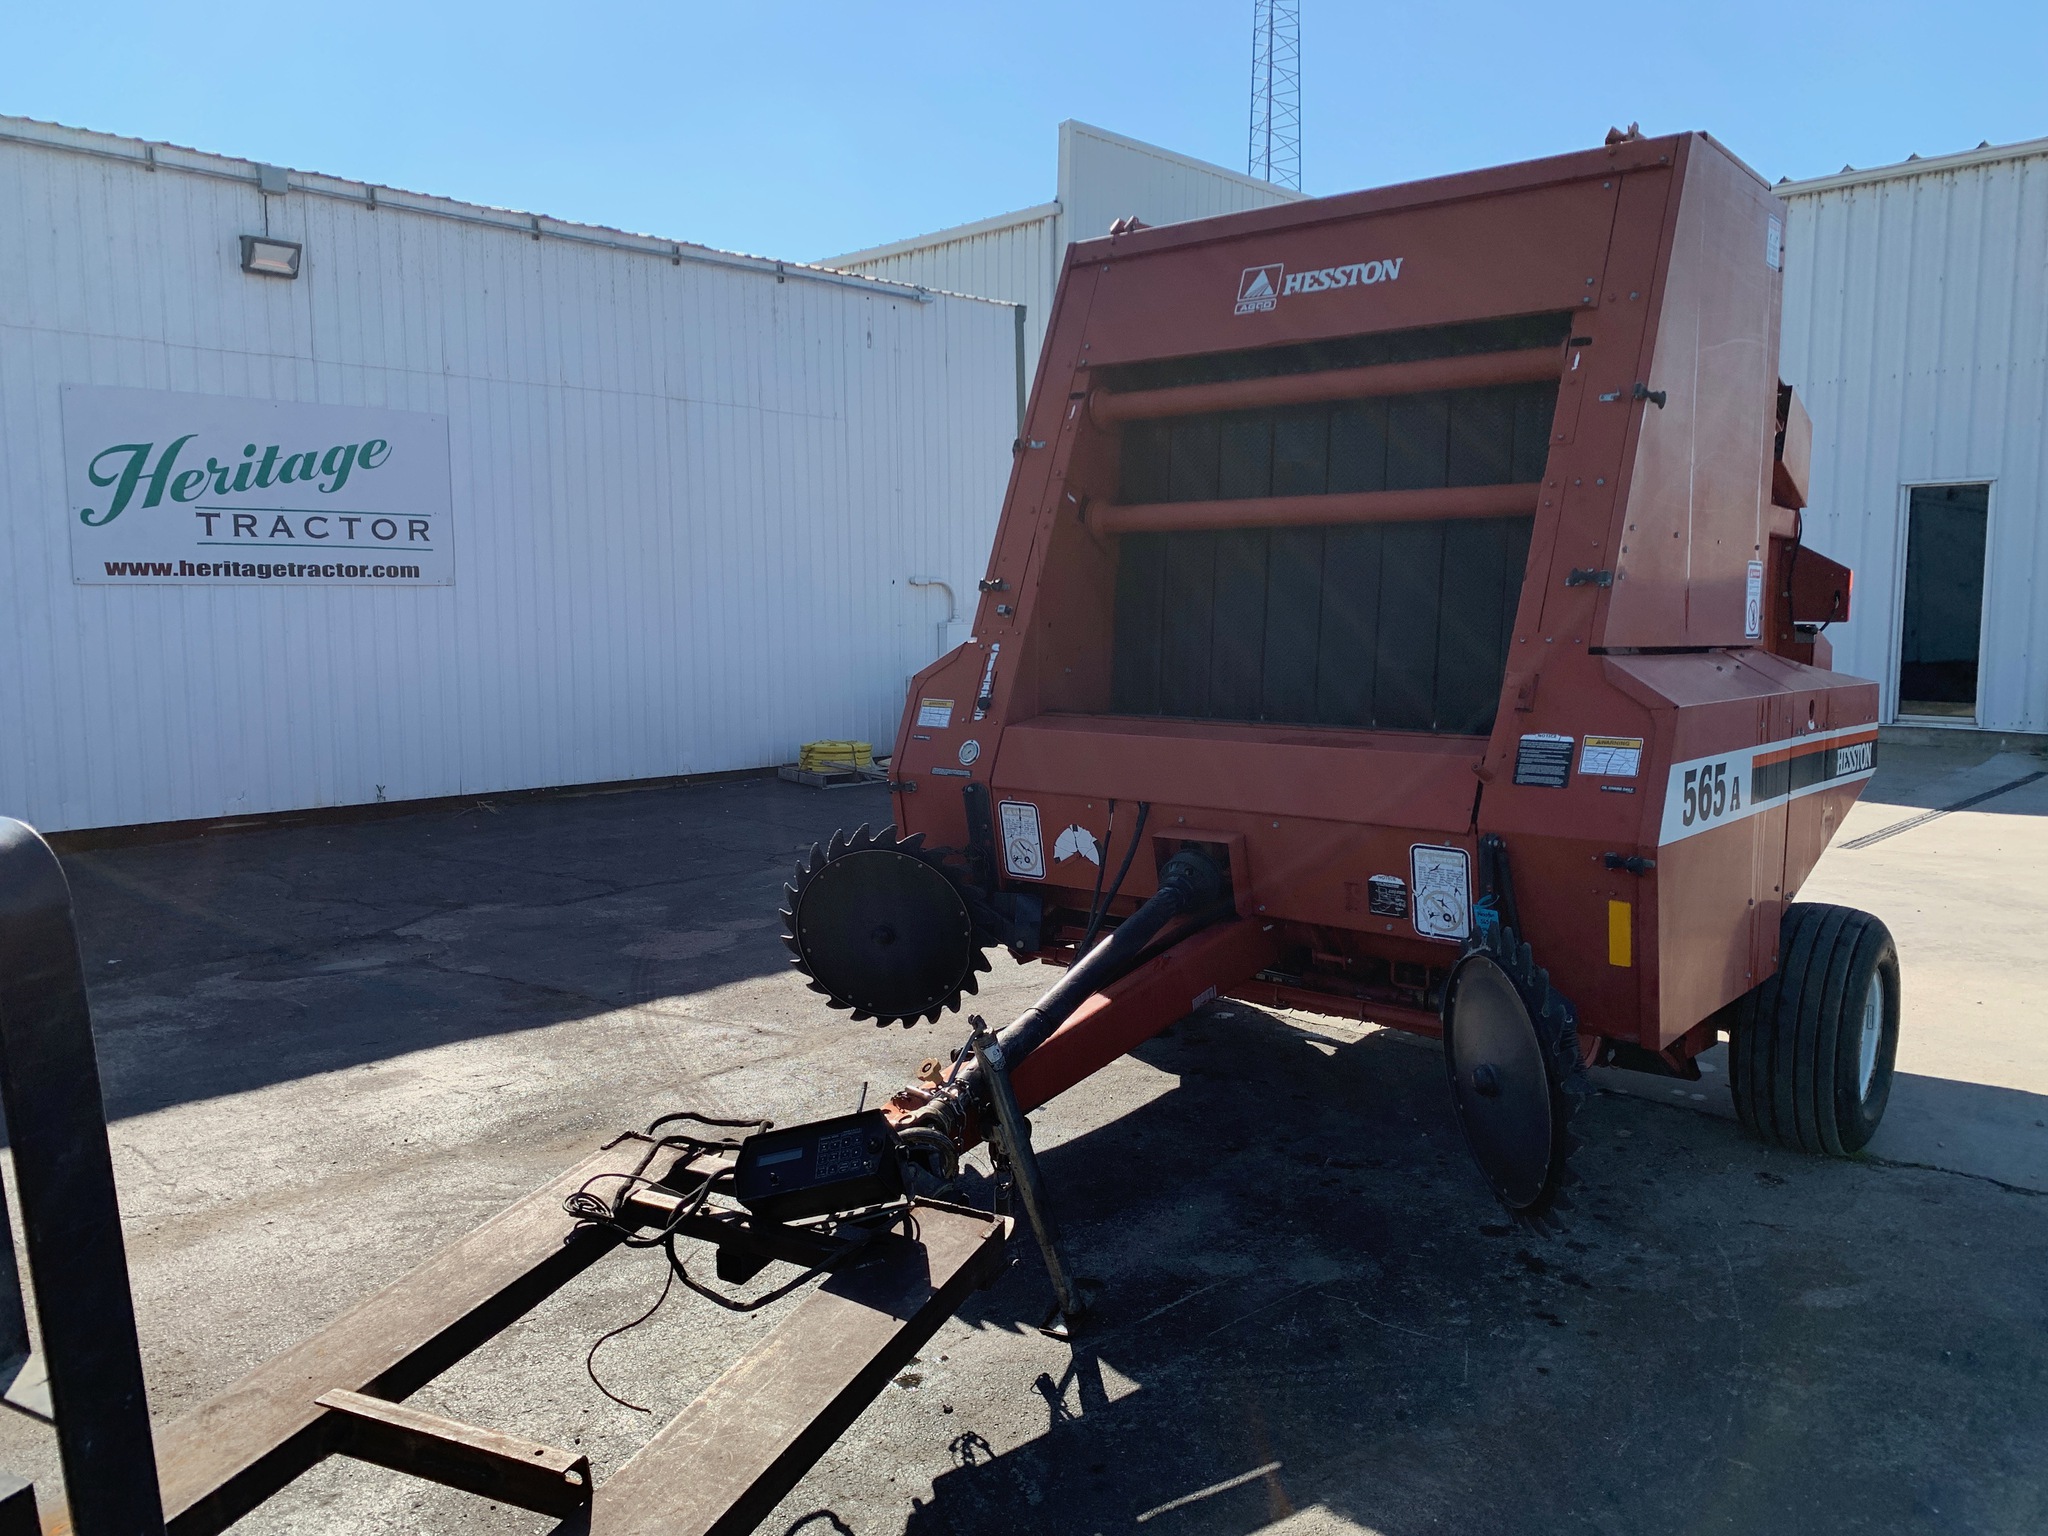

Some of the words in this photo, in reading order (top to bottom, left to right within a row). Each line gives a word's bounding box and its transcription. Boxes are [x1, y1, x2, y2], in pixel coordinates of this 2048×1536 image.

[1282, 258, 1403, 296] HESSTON
[1240, 302, 1272, 312] AGCO
[80, 434, 393, 527] Heritage
[195, 512, 431, 542] TRACTOR
[104, 559, 420, 579] www.heritagetractor.com
[1836, 742, 1873, 776] HESSTON
[1682, 762, 1727, 827] 565
